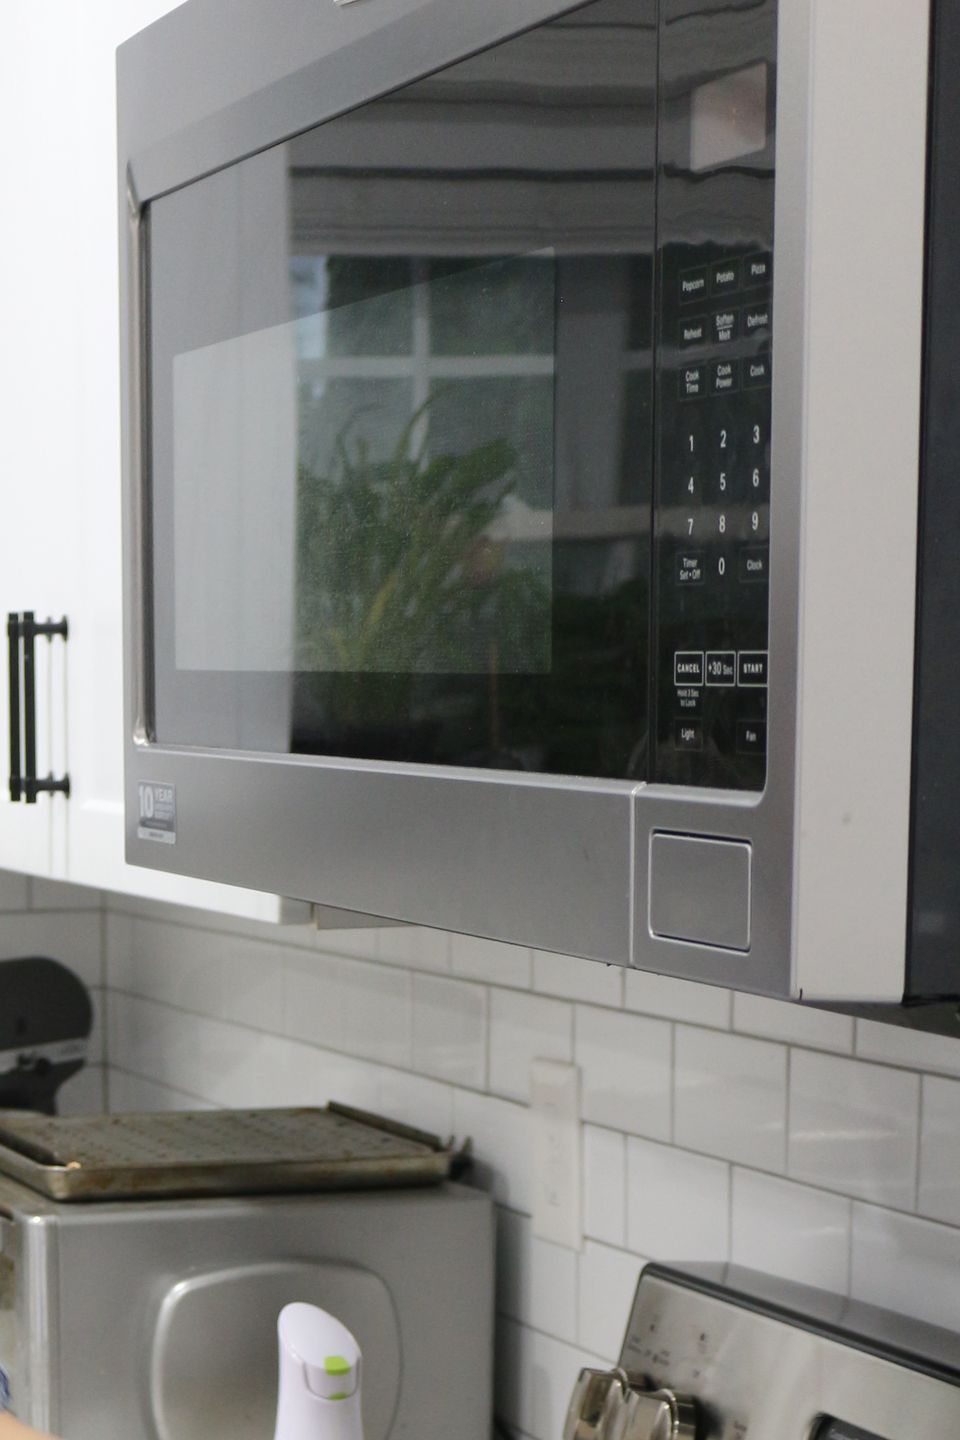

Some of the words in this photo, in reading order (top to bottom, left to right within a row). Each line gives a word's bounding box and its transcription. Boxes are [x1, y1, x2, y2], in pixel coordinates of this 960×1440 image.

[716, 271, 735, 283] Potato
[682, 279, 705, 292] Popcorn
[716, 314, 734, 327] Soften
[747, 313, 768, 328] Defrost
[684, 327, 702, 340] Reheat
[719, 329, 731, 341] Melt
[685, 370, 700, 382] Cook
[717, 364, 731, 377] Cook
[750, 364, 765, 377] Cook
[686, 383, 699, 393] Time
[716, 377, 733, 389] Power
[720, 429, 727, 449] 2
[753, 424, 760, 444] 3
[689, 434, 694, 453] 1
[720, 472, 726, 491] 5
[752, 467, 760, 488] 6
[687, 476, 694, 494] 4
[687, 518, 694, 536] 7
[719, 514, 726, 533] 8
[751, 511, 759, 531] 9
[683, 558, 698, 568] Timer
[718, 557, 726, 576] 0
[746, 559, 763, 571] Clock
[677, 663, 700, 673] CANCEL
[708, 661, 722, 675] +30
[722, 664, 733, 675] Sec
[743, 663, 763, 674] START
[681, 728, 695, 741] Light
[745, 730, 757, 742] Fan
[139, 785, 153, 818] 10
